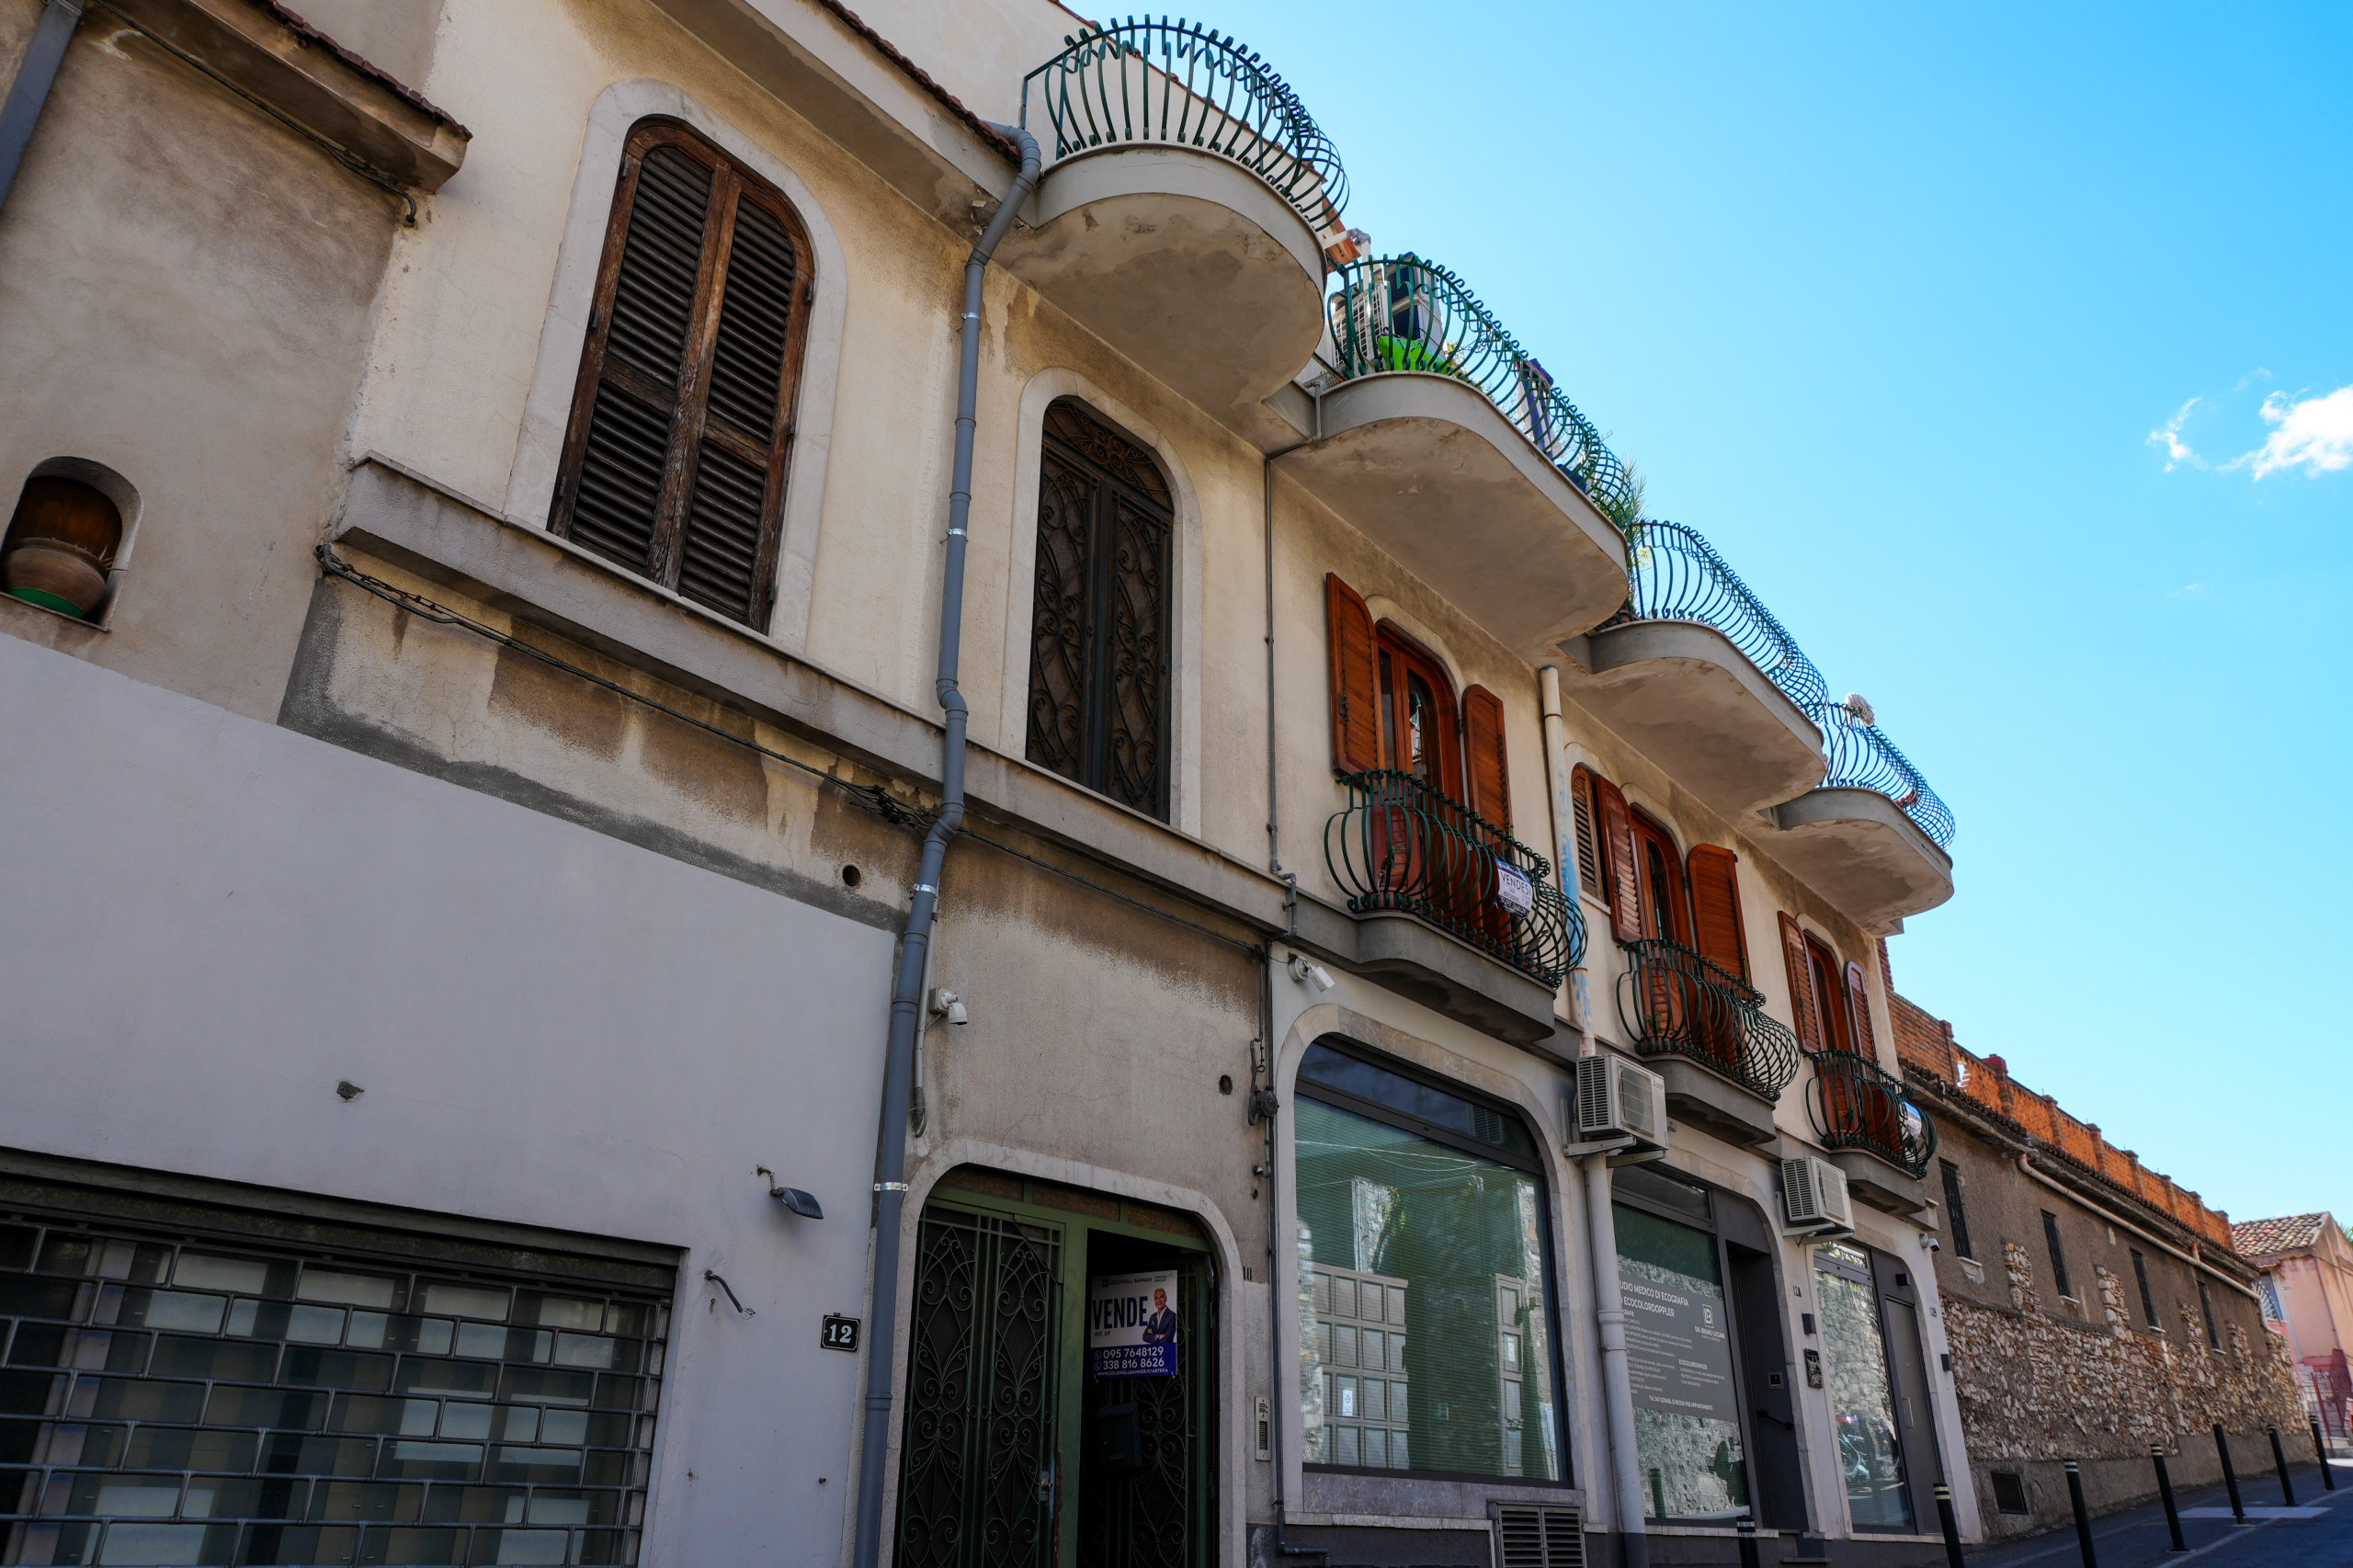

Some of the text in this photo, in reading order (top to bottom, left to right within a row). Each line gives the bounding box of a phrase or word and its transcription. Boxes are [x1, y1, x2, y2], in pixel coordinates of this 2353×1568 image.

[1500, 870, 1531, 896] VENDESI
[1620, 1280, 1689, 1307] UDIO MEDICO DI ECOGRAFIA
[1092, 1296, 1148, 1330] VENDE
[1623, 1296, 1675, 1317] ECOCOLORDOPPLER
[828, 1324, 853, 1344] 12
[1103, 1346, 1165, 1359] 095 7648129
[1102, 1357, 1165, 1370] 338 816 8626
